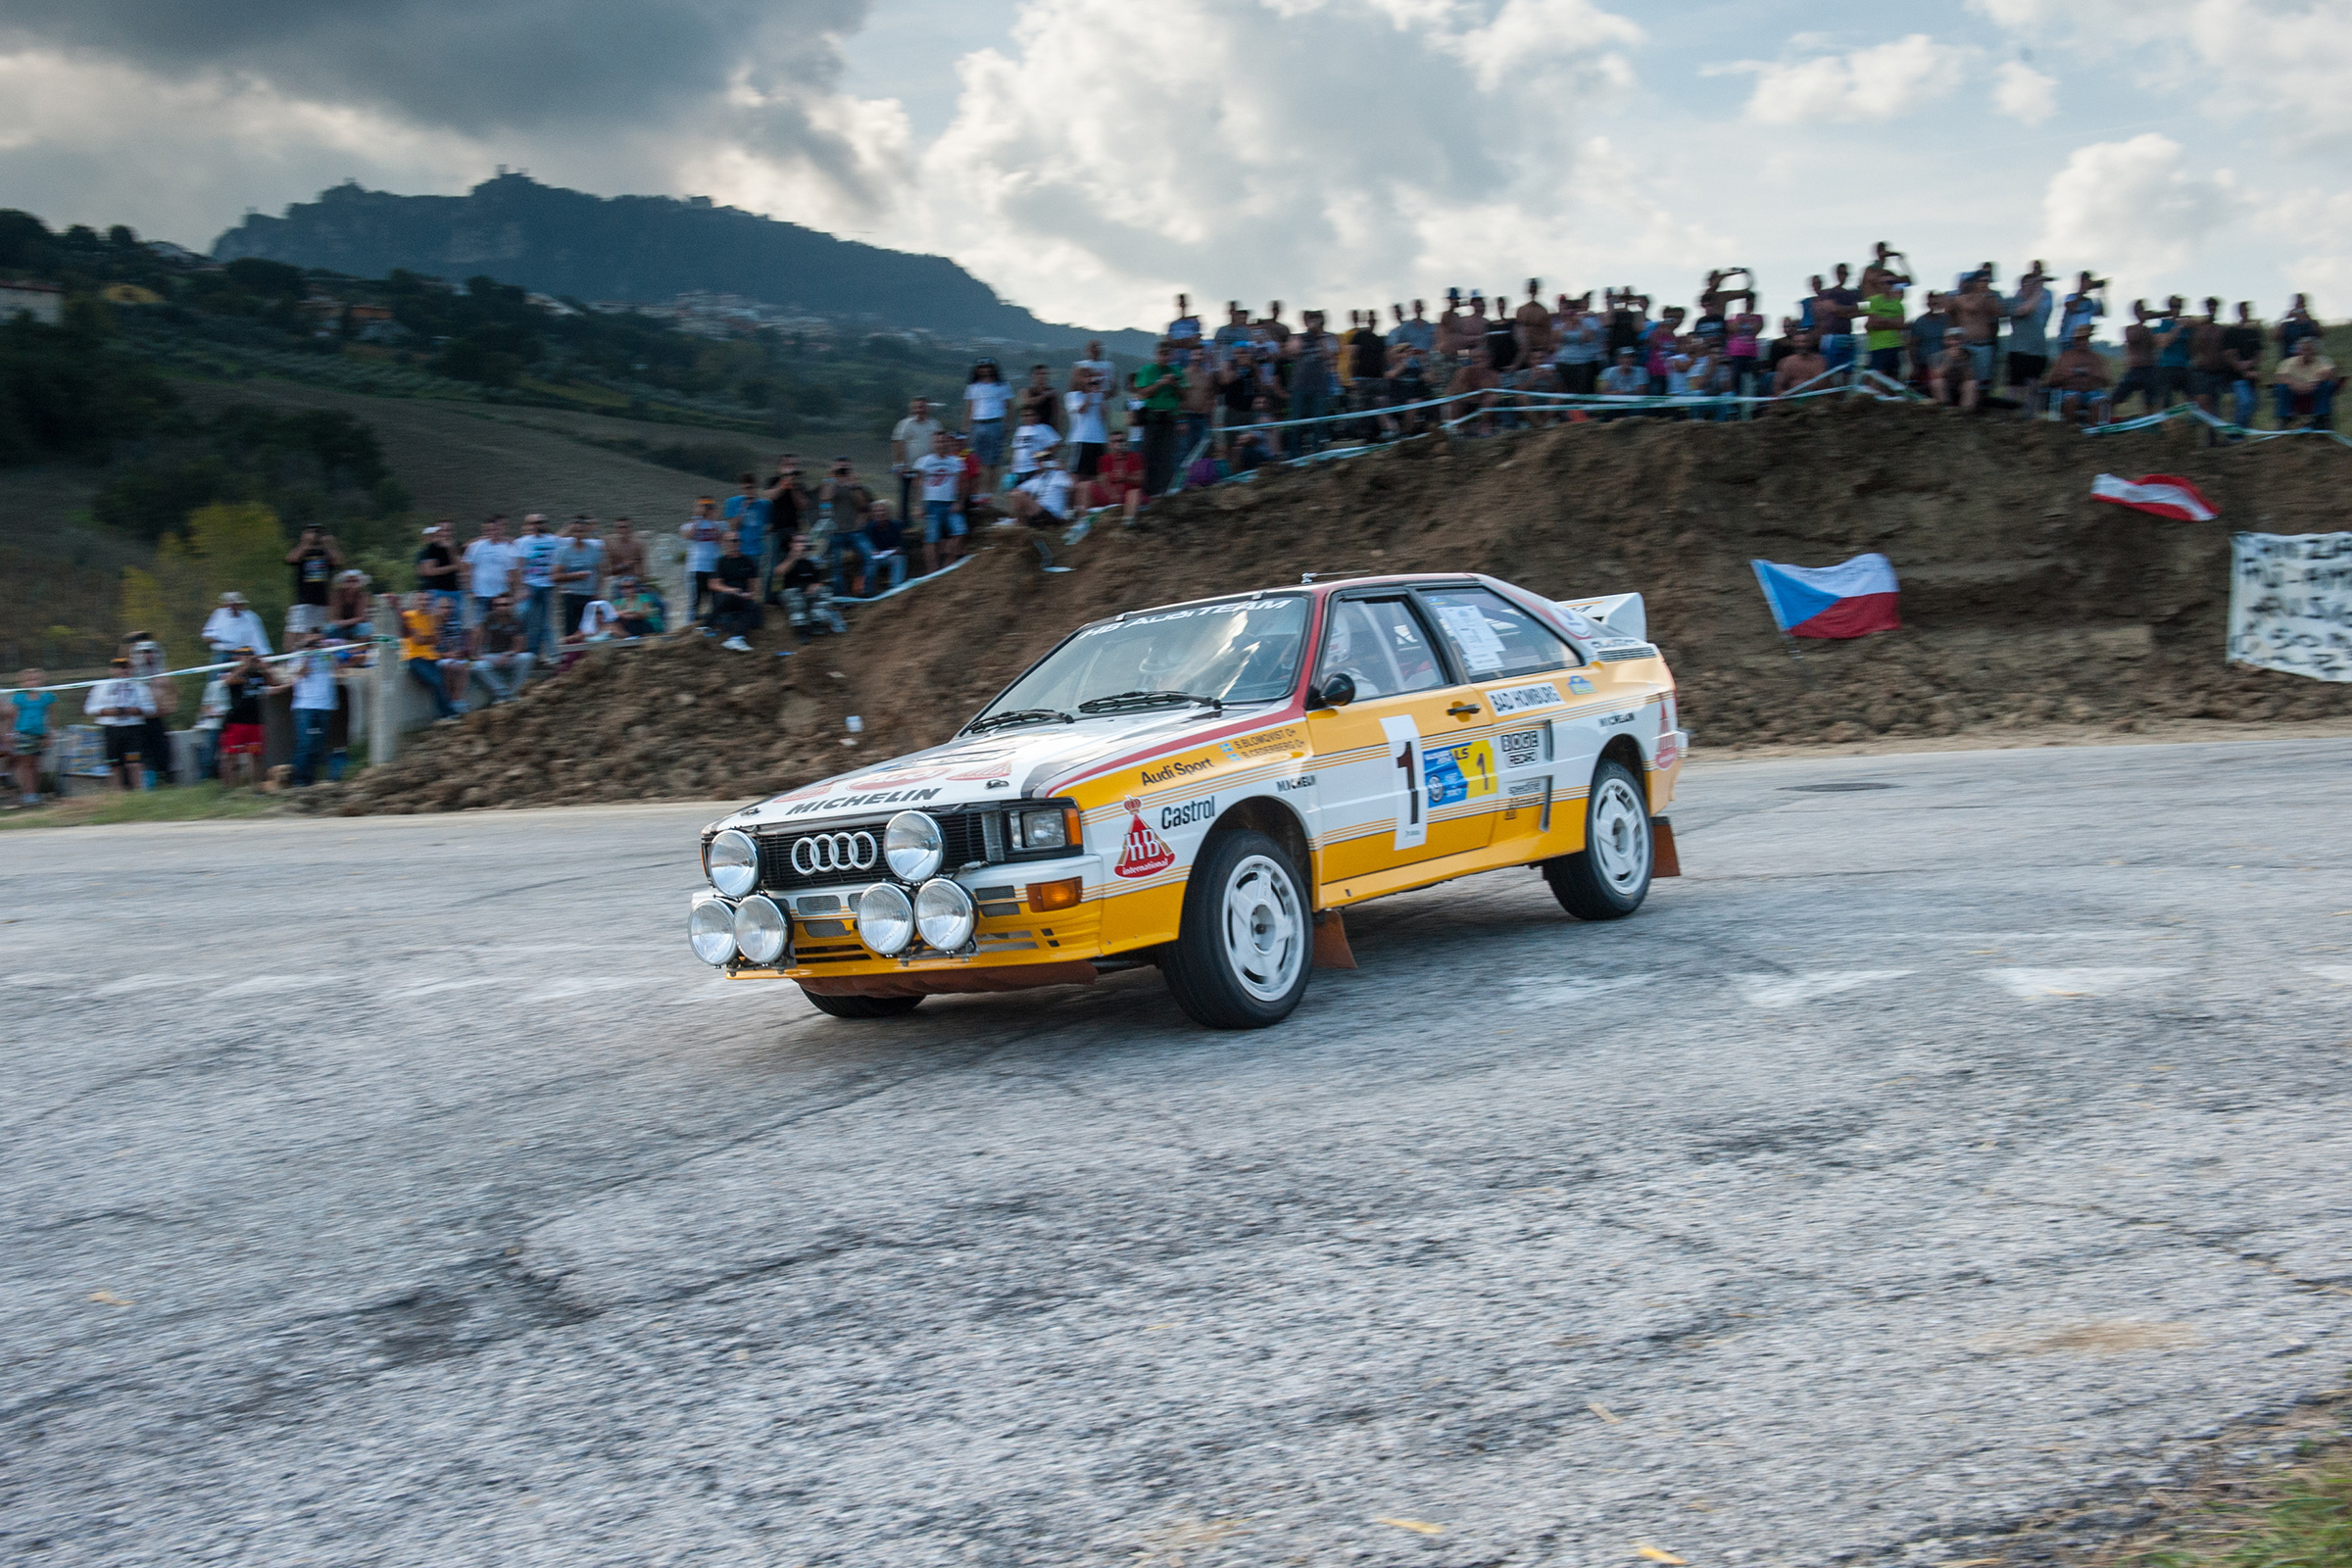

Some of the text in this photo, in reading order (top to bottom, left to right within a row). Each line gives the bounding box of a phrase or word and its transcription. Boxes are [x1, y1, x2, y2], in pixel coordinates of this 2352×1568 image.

[1079, 621, 1124, 640] HB
[1197, 599, 1293, 616] TEAM
[1500, 730, 1539, 752] BOGE
[1141, 758, 1215, 787] Audi Sport
[1396, 741, 1418, 824] 1
[1477, 753, 1489, 791] 1
[785, 787, 943, 816] MICHELIN
[1161, 795, 1215, 830] Castrol
[1124, 828, 1160, 861] HB
